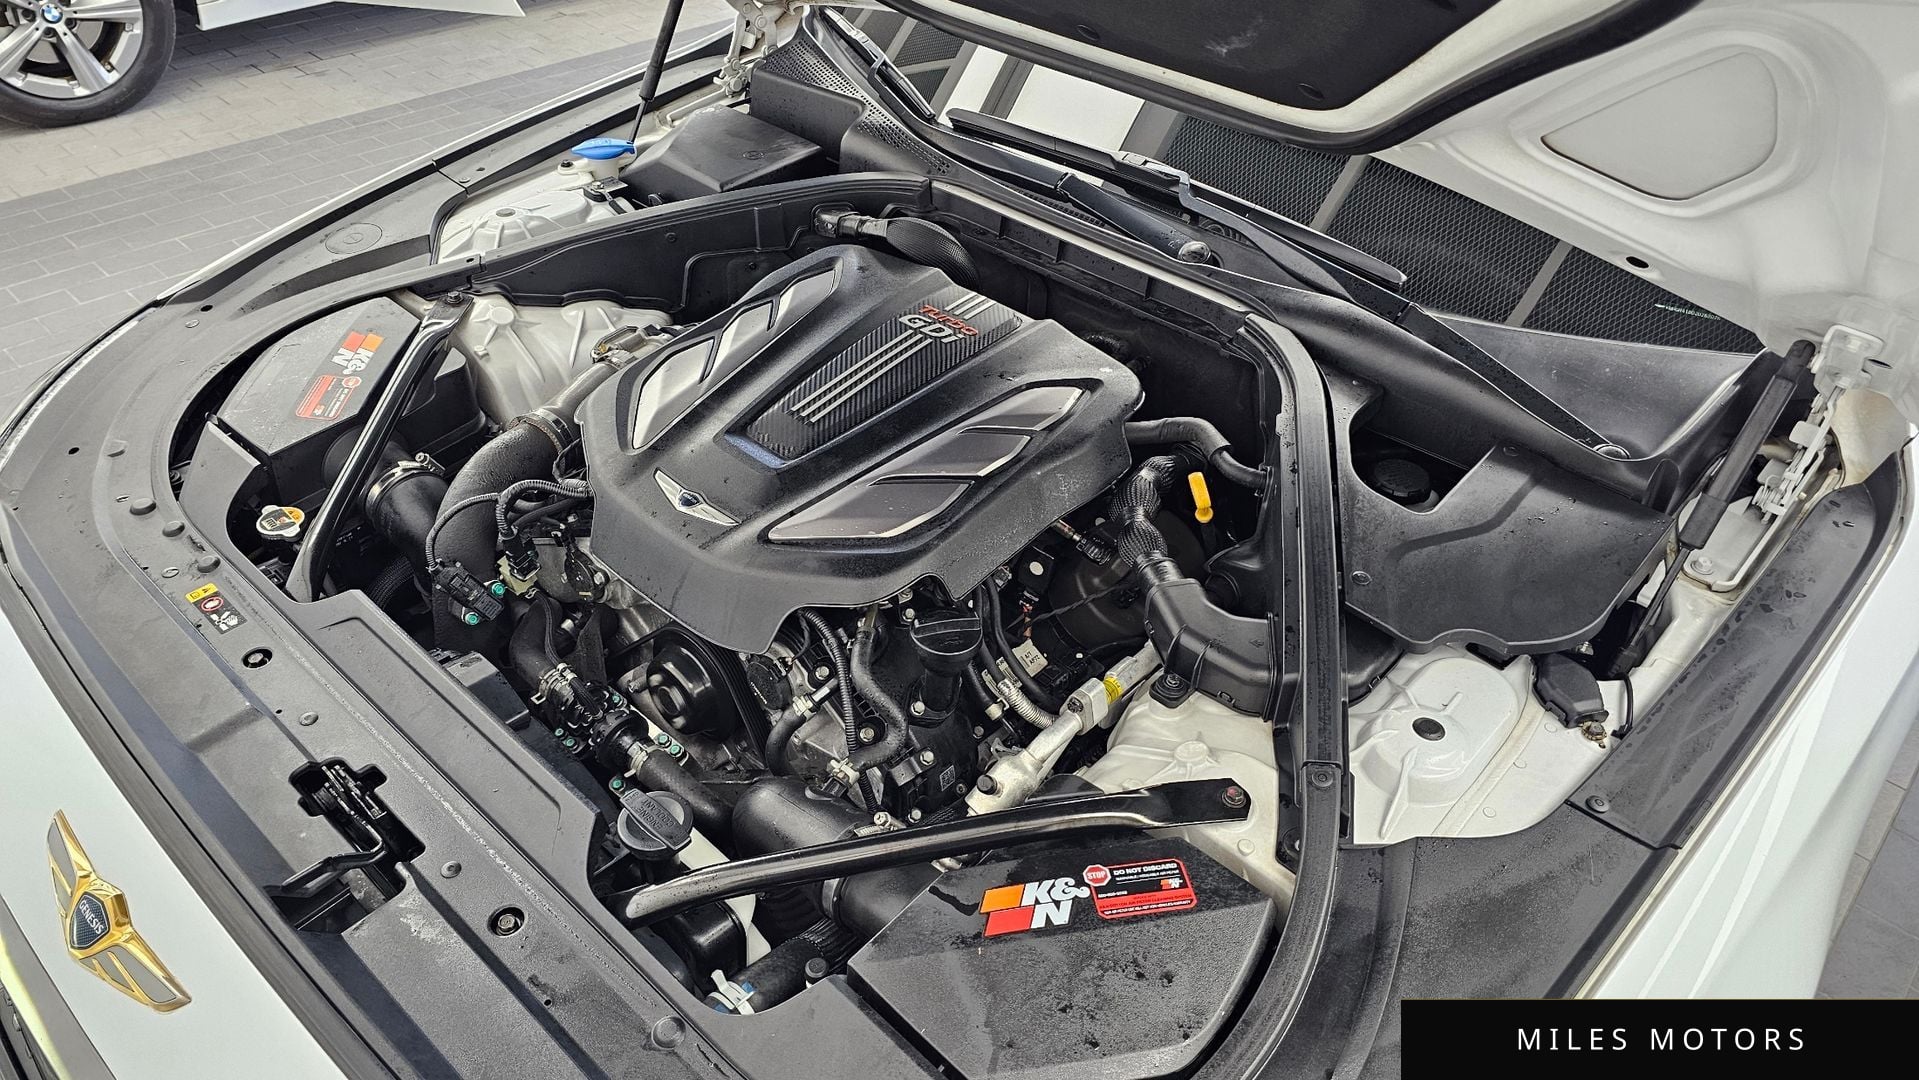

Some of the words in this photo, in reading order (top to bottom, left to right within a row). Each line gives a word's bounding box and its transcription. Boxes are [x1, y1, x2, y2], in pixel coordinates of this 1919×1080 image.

[641, 796, 675, 828] COOLANT
[1087, 870, 1107, 881] STOP
[1126, 866, 1142, 874] NOT
[1143, 862, 1178, 872] DISCARD
[79, 899, 105, 934] GENESIS
